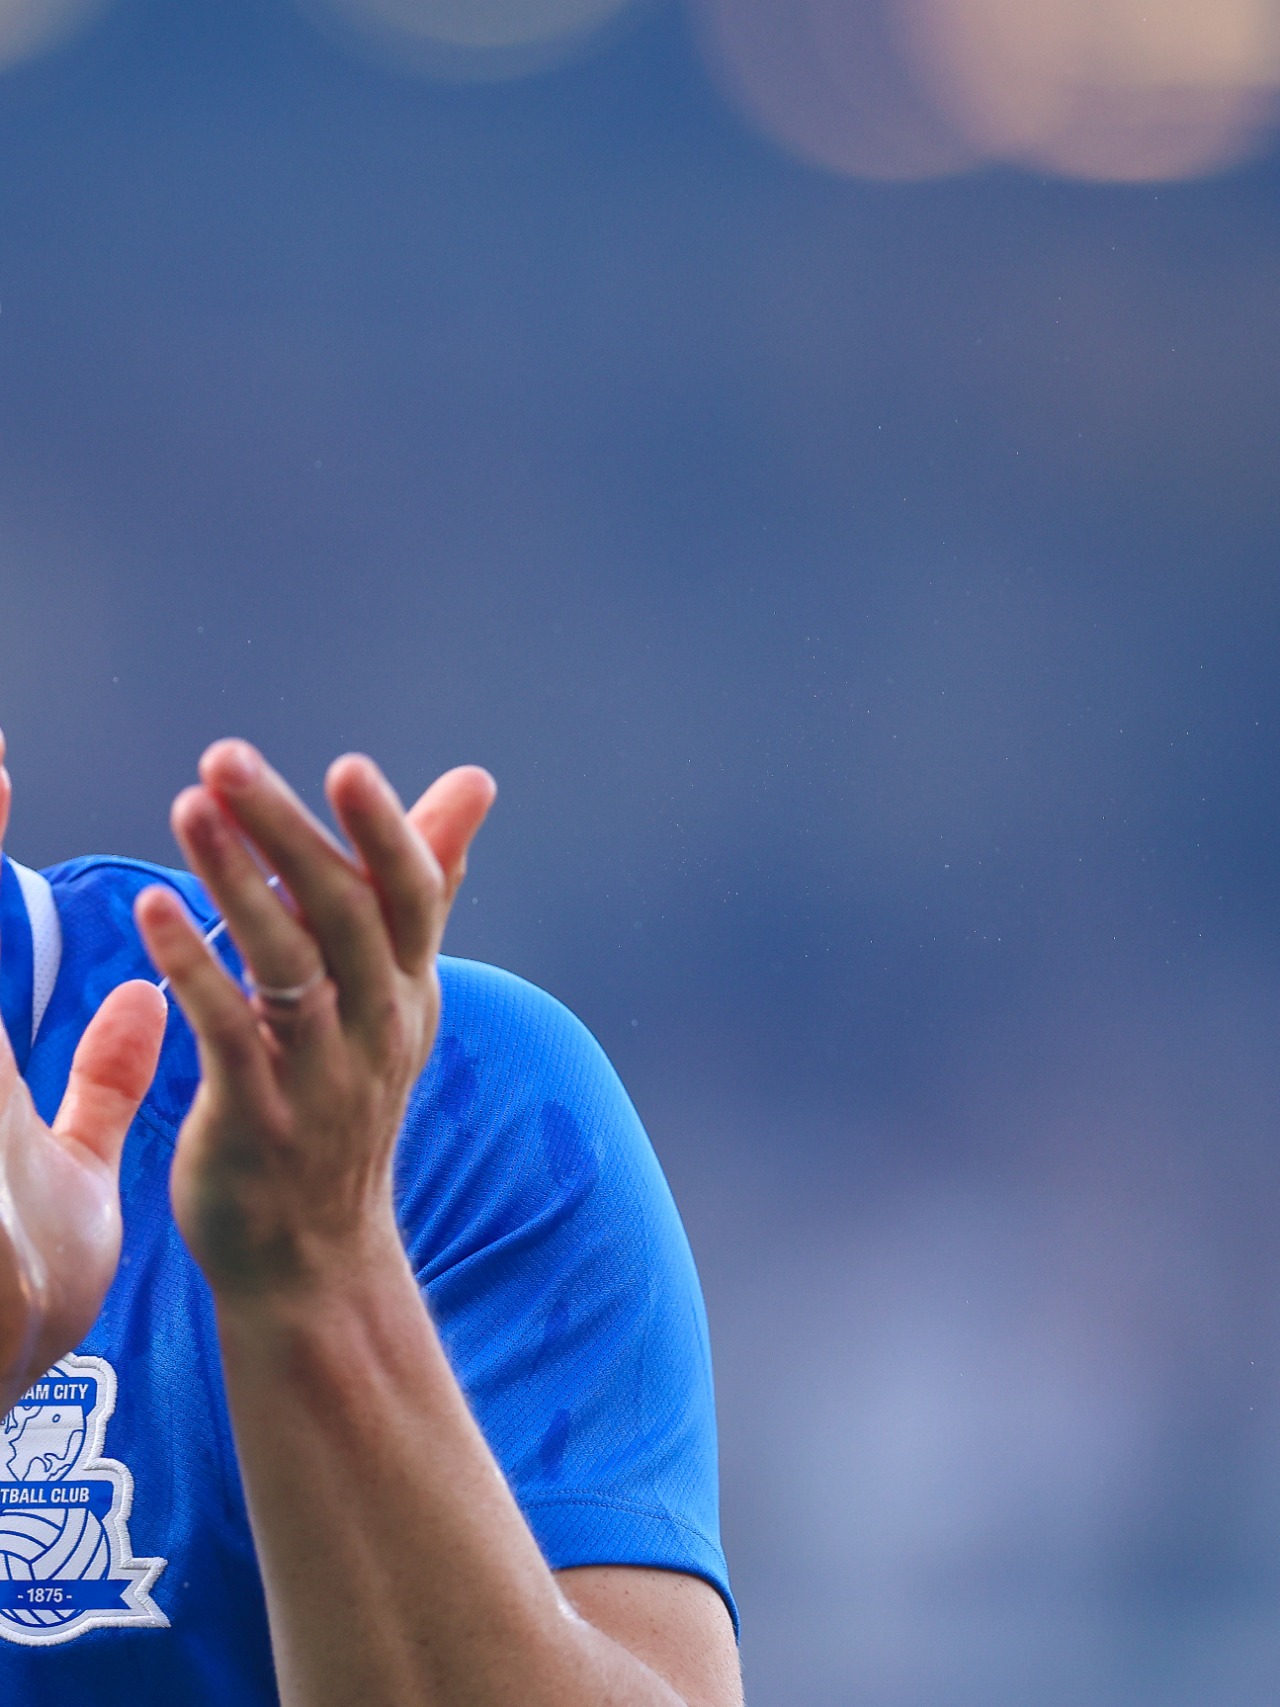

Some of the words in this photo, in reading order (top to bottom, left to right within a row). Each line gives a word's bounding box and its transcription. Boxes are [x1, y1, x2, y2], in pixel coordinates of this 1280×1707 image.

[20, 1384, 50, 1400] AM
[53, 1383, 89, 1400] CITY
[50, 1487, 90, 1503] CLUB
